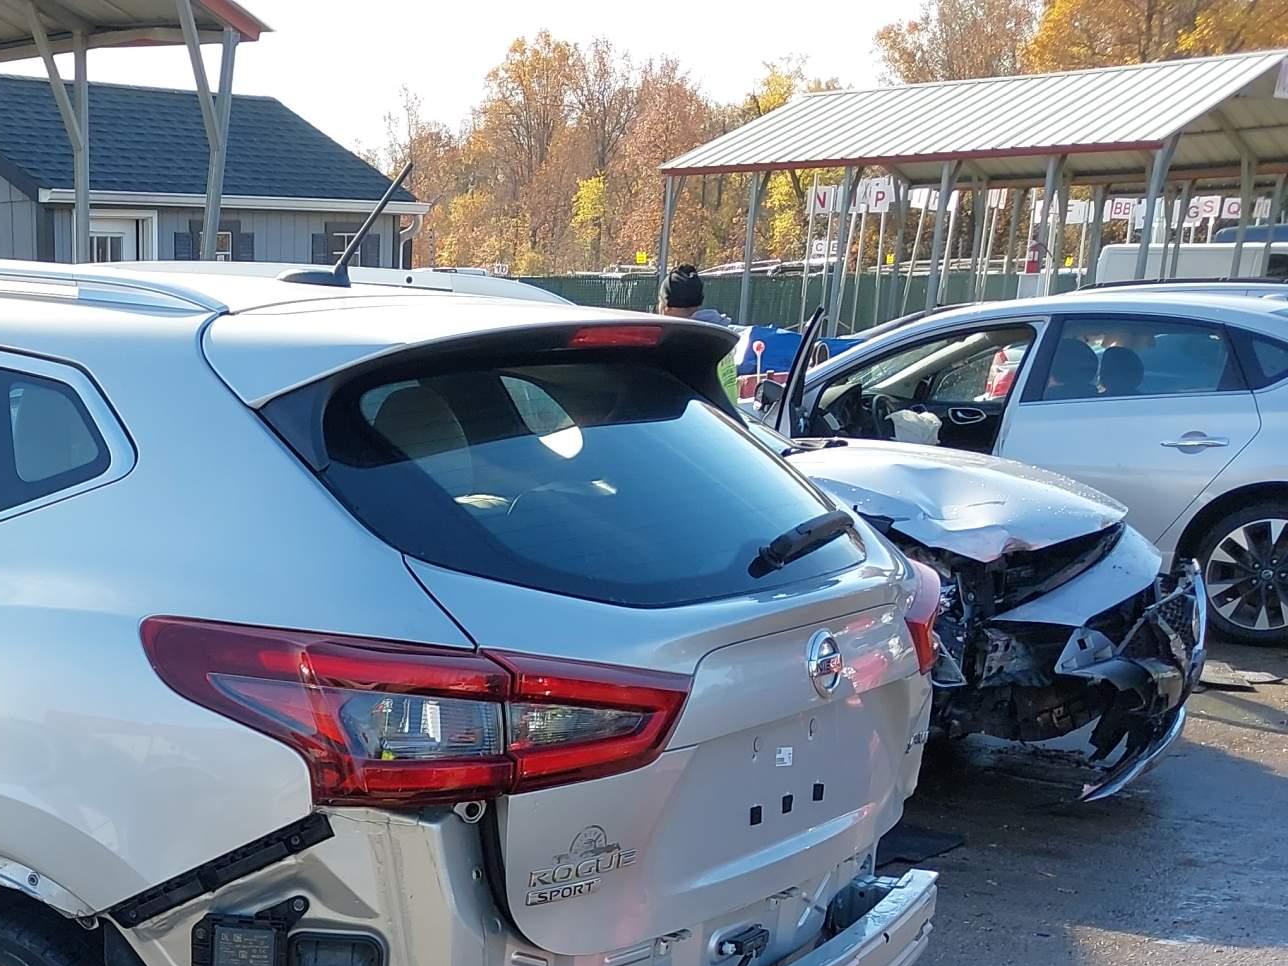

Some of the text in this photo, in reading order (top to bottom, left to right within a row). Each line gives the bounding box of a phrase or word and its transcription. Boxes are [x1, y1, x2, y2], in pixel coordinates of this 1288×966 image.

[816, 191, 827, 209] N
[875, 191, 885, 207] P
[1203, 200, 1214, 213] S
[1187, 206, 1199, 218] G
[1227, 201, 1241, 216] Q
[528, 848, 638, 887] ROGUE
[537, 880, 595, 904] SPORT
